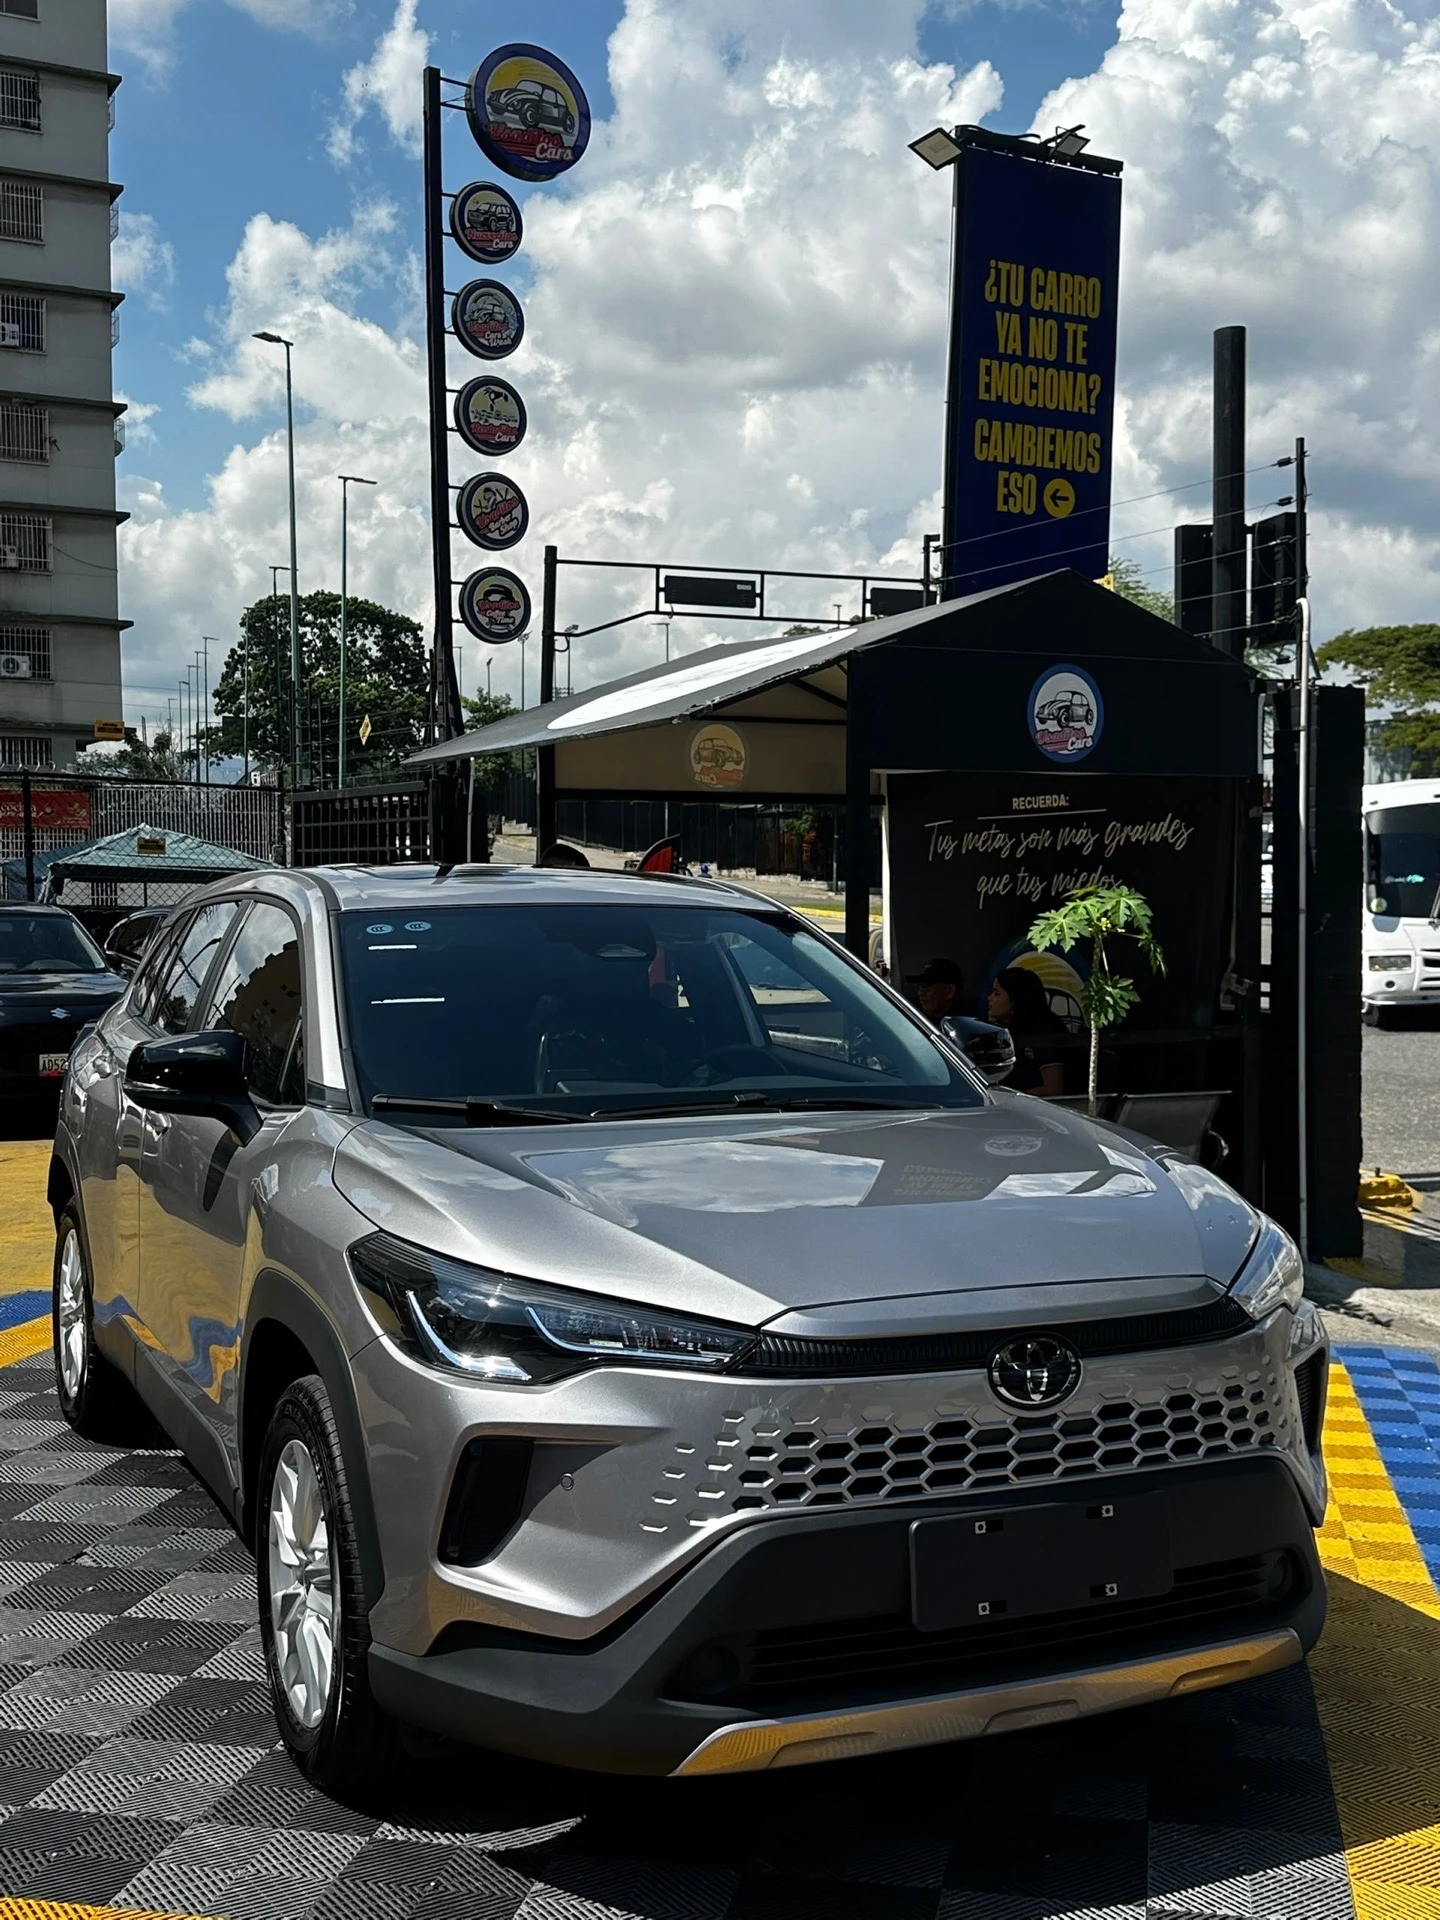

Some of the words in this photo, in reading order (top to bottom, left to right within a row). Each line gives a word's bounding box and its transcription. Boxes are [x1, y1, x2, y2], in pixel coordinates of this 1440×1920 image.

[535, 143, 574, 160] Cars
[492, 239, 514, 249] Cars
[984, 259, 1024, 308] ¿TU
[1030, 267, 1101, 319] CARRO
[995, 311, 1022, 356] YA
[1028, 316, 1058, 362] NO
[1064, 322, 1088, 366] TE
[978, 358, 1101, 415] EMOCIONA?
[495, 432, 516, 442] Cars
[974, 418, 1101, 474] CAMBIEMOS
[996, 470, 1037, 515] ESO
[1035, 727, 1085, 745] Usaditos
[1067, 736, 1093, 750] Cars
[1012, 795, 1070, 810] RECUERDA:
[924, 819, 958, 862] Tus
[962, 823, 1015, 858] metas
[1016, 828, 1053, 858] son
[1057, 821, 1099, 855] más
[976, 873, 1013, 910] que
[1016, 866, 1047, 902] tus
